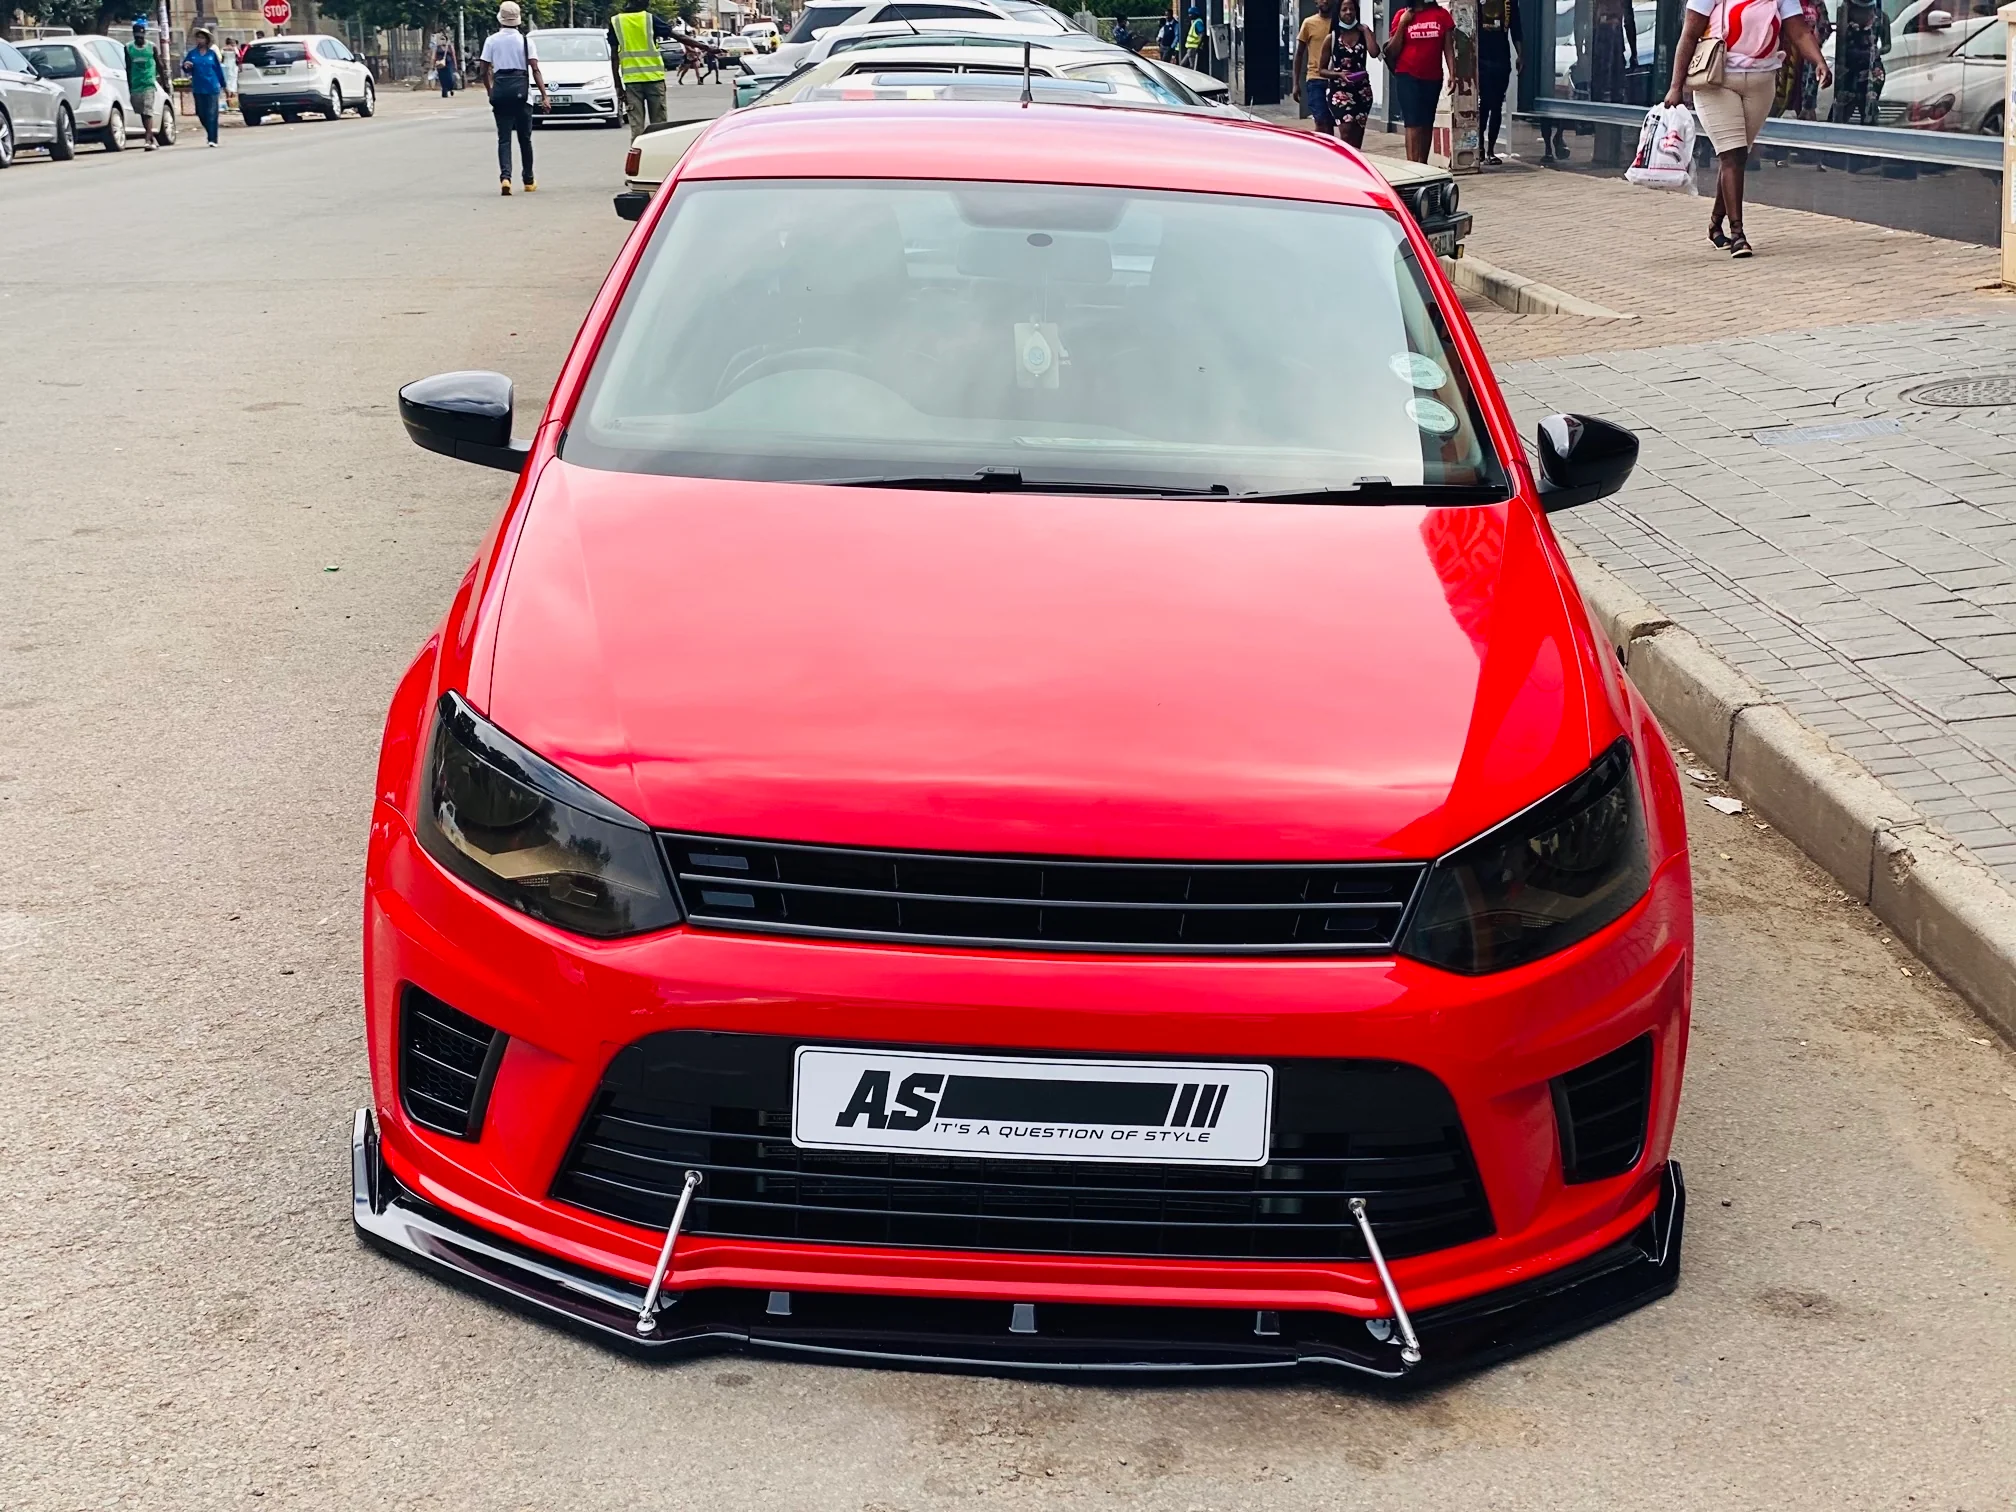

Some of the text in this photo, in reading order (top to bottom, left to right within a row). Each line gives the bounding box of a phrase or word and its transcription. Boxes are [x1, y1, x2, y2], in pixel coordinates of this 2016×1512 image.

[265, 5, 288, 17] STOP
[1410, 30, 1439, 39] COLLEGE
[835, 1070, 945, 1131] AS
[934, 1123, 1211, 1143] IT'S A QUESTION OF STYLE
